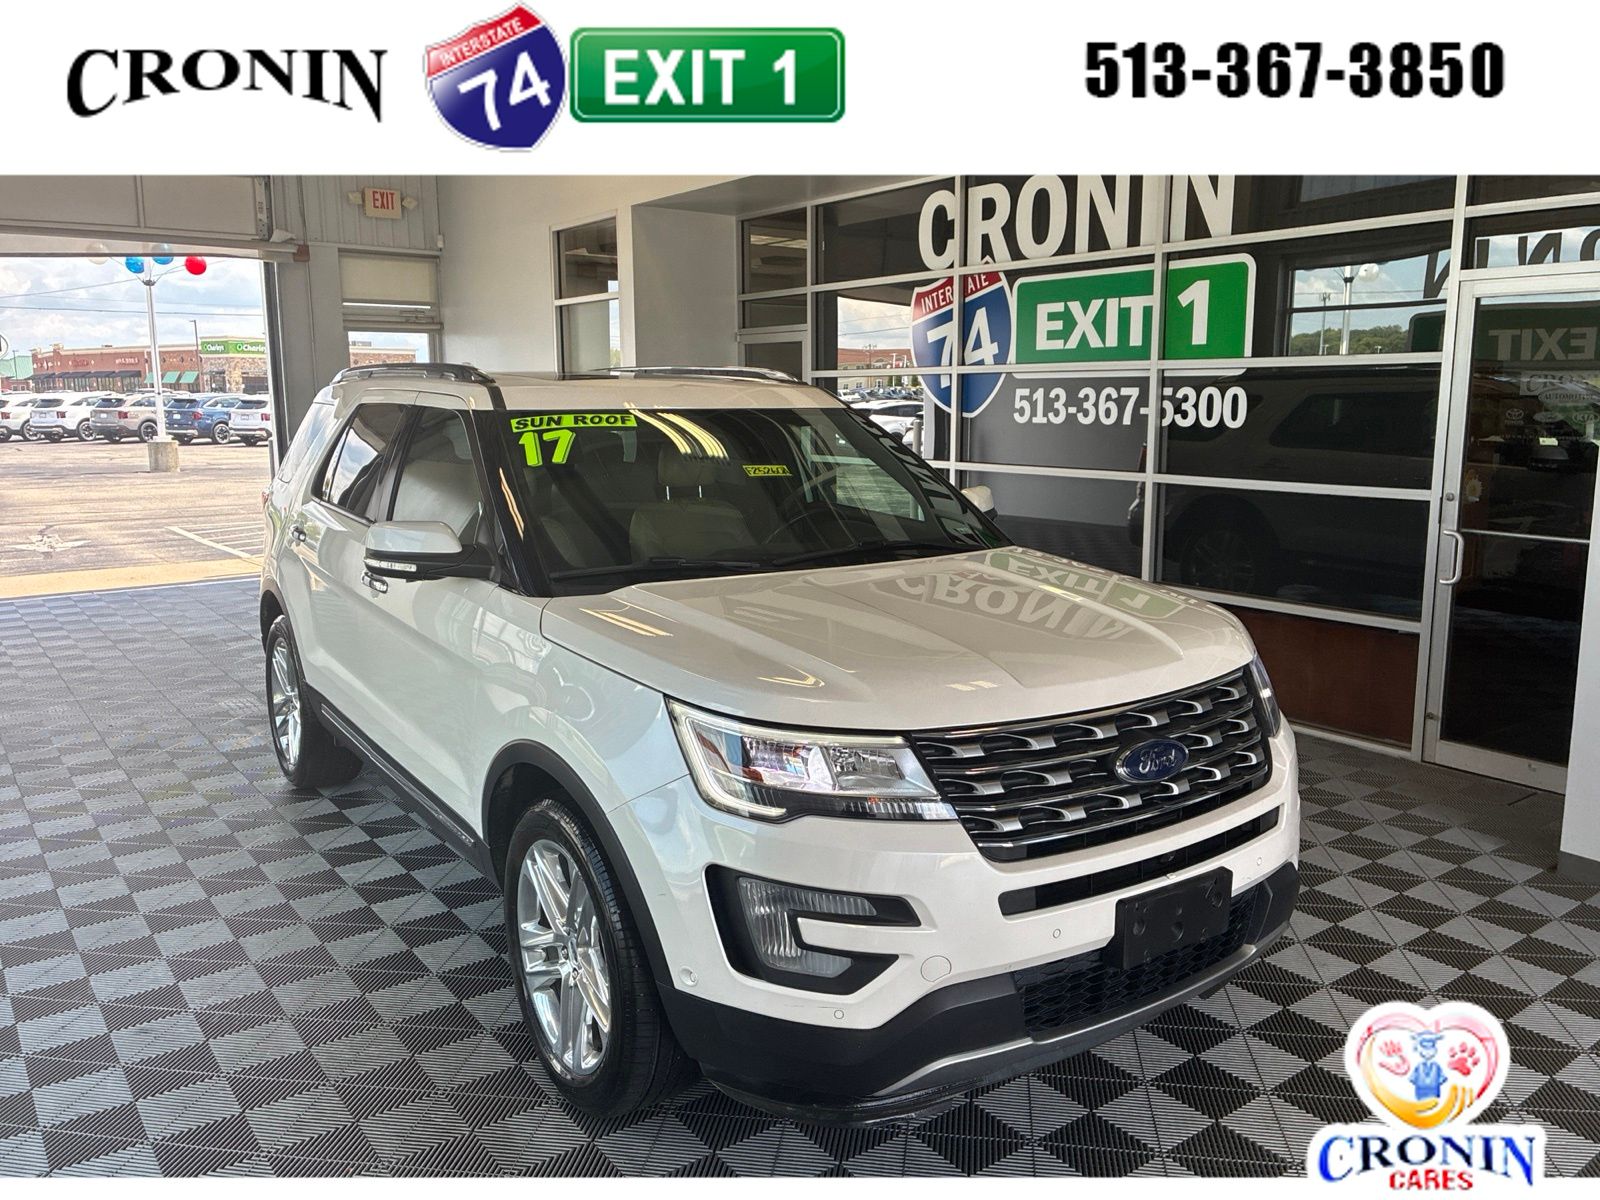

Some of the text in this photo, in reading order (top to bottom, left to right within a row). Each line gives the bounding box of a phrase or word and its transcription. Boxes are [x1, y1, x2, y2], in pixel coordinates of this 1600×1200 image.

[372, 190, 396, 210] EXIT
[918, 174, 1236, 271] CRONIN
[921, 274, 990, 314] INTERATE
[1036, 280, 1210, 350] EXIT 1
[926, 306, 999, 389] 74
[515, 415, 632, 429] SUN ROOF
[519, 429, 577, 466] 17
[1139, 747, 1177, 773] Ford
